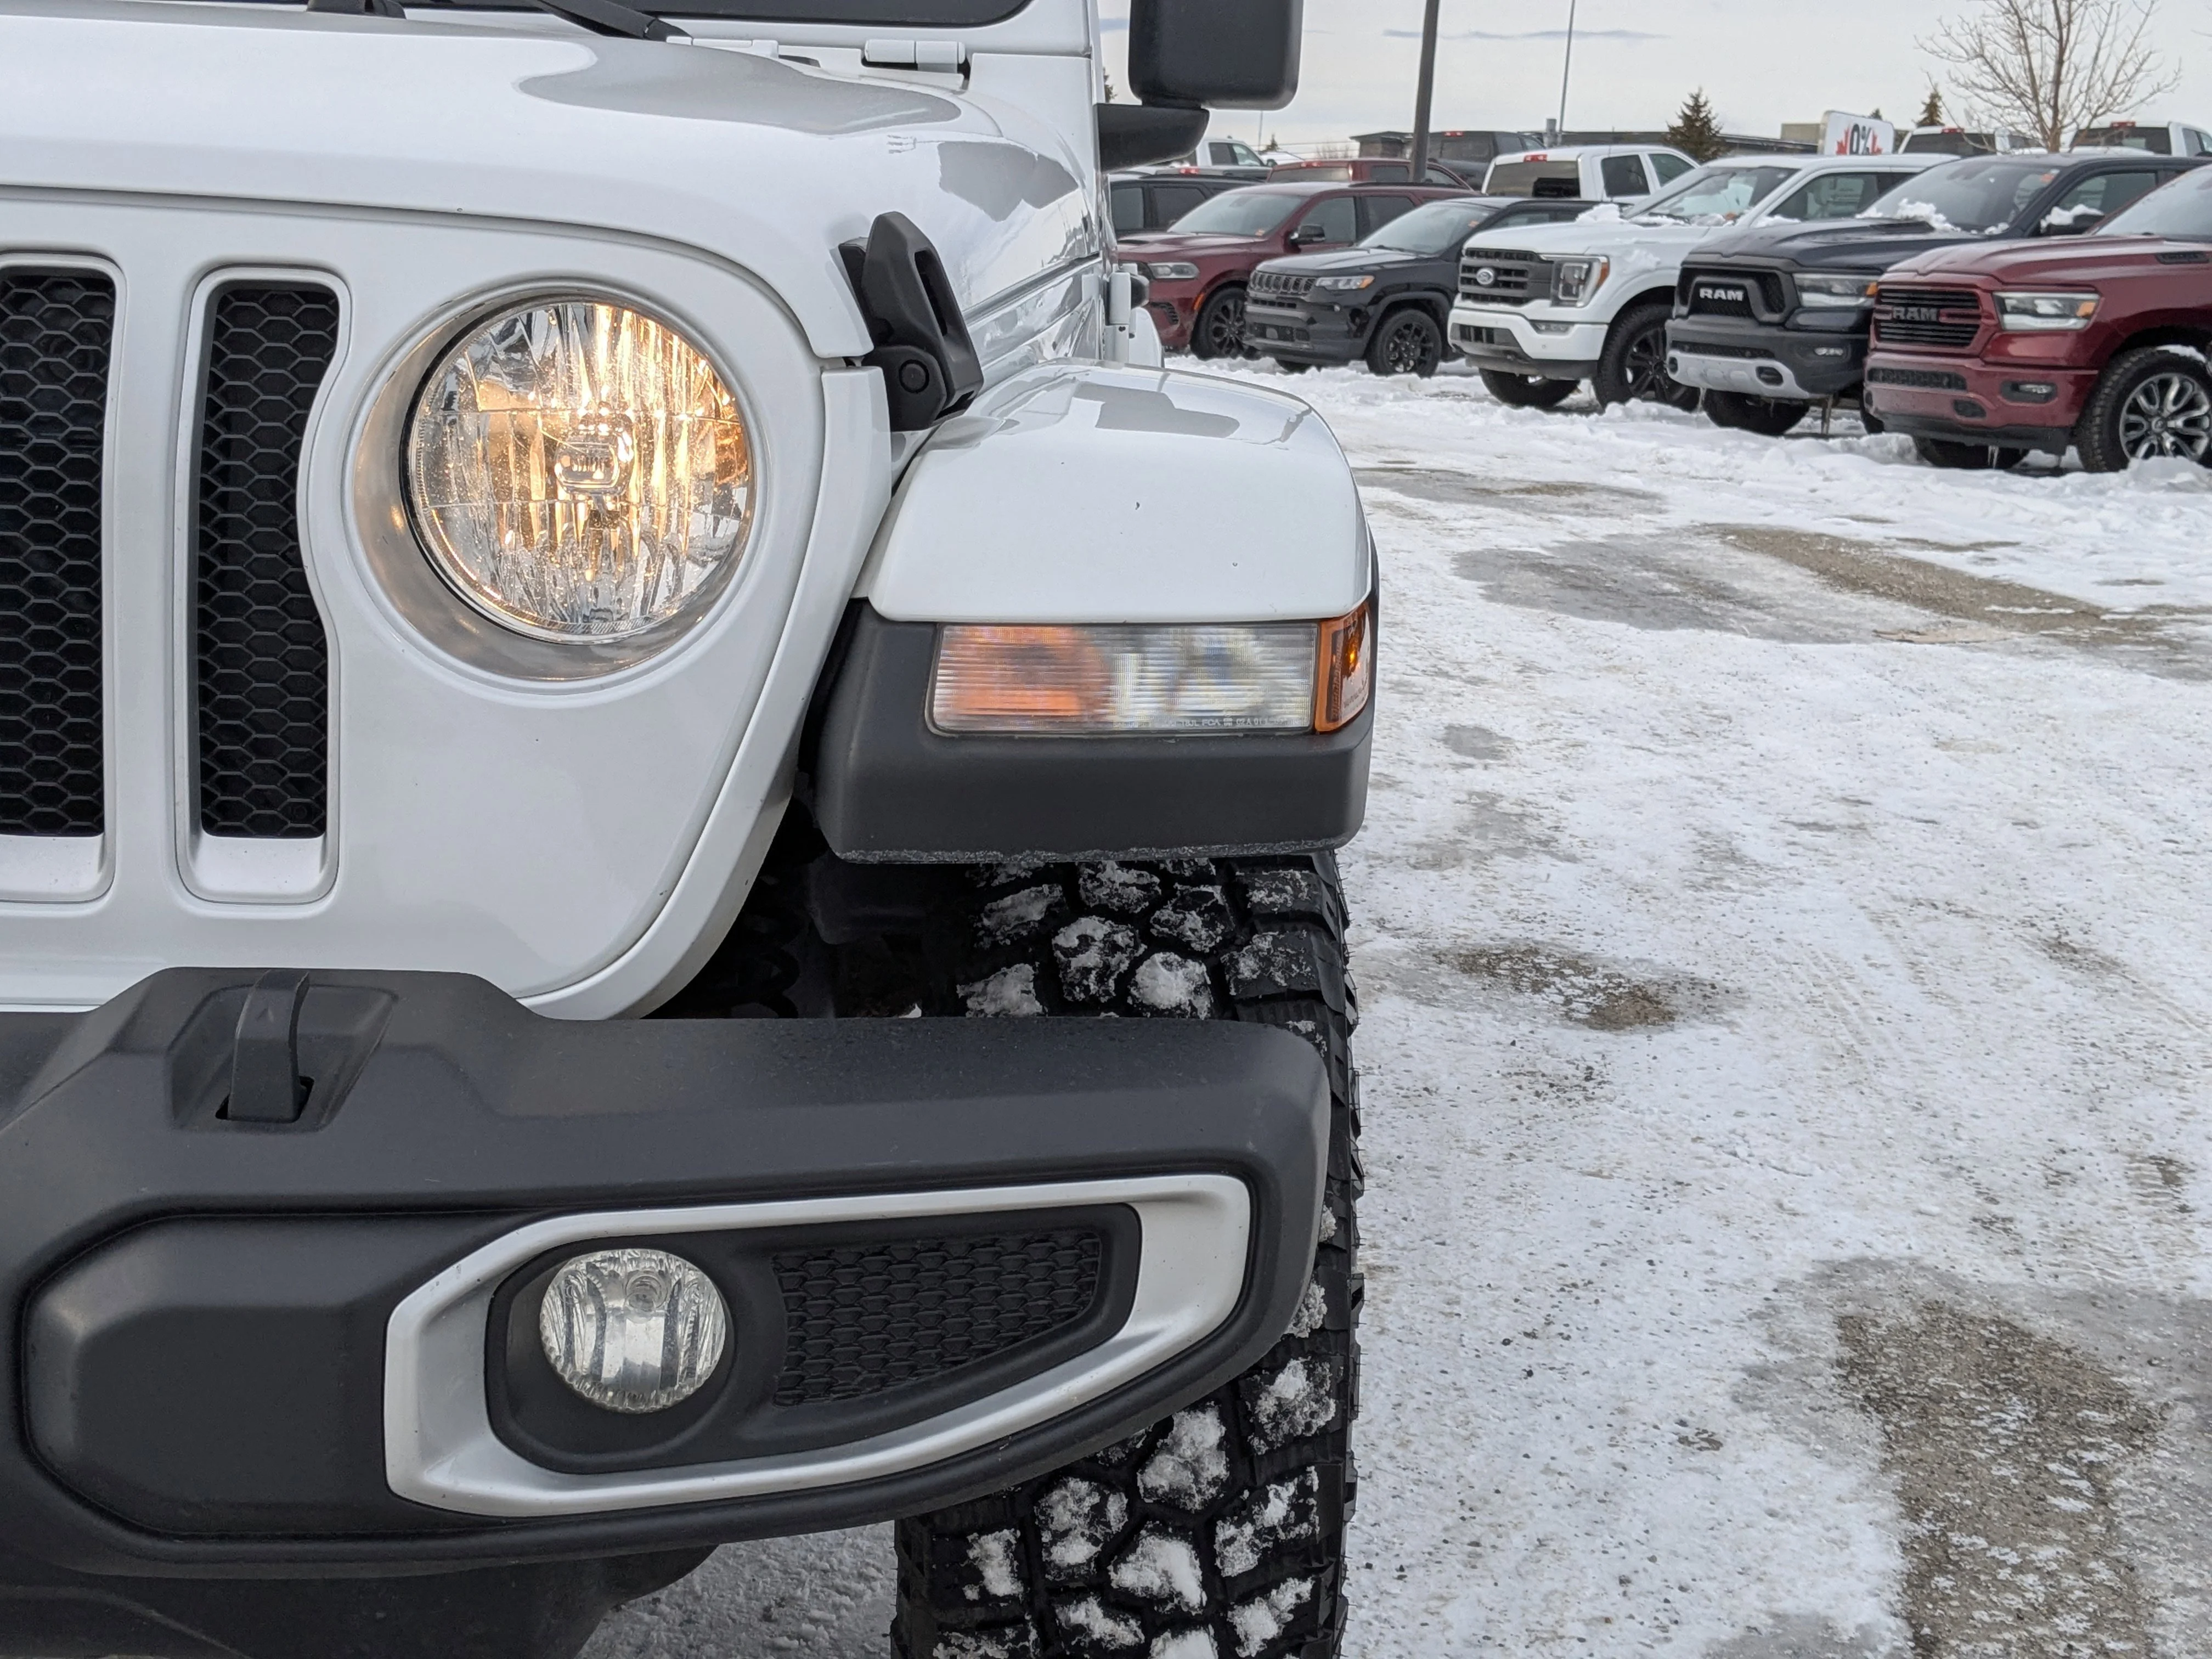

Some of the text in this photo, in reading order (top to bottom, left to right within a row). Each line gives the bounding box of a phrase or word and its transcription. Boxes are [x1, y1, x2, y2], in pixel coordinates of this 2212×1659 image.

[1849, 122, 1872, 155] 0%
[1699, 287, 1745, 302] RAM
[1892, 306, 1938, 322] RAM
